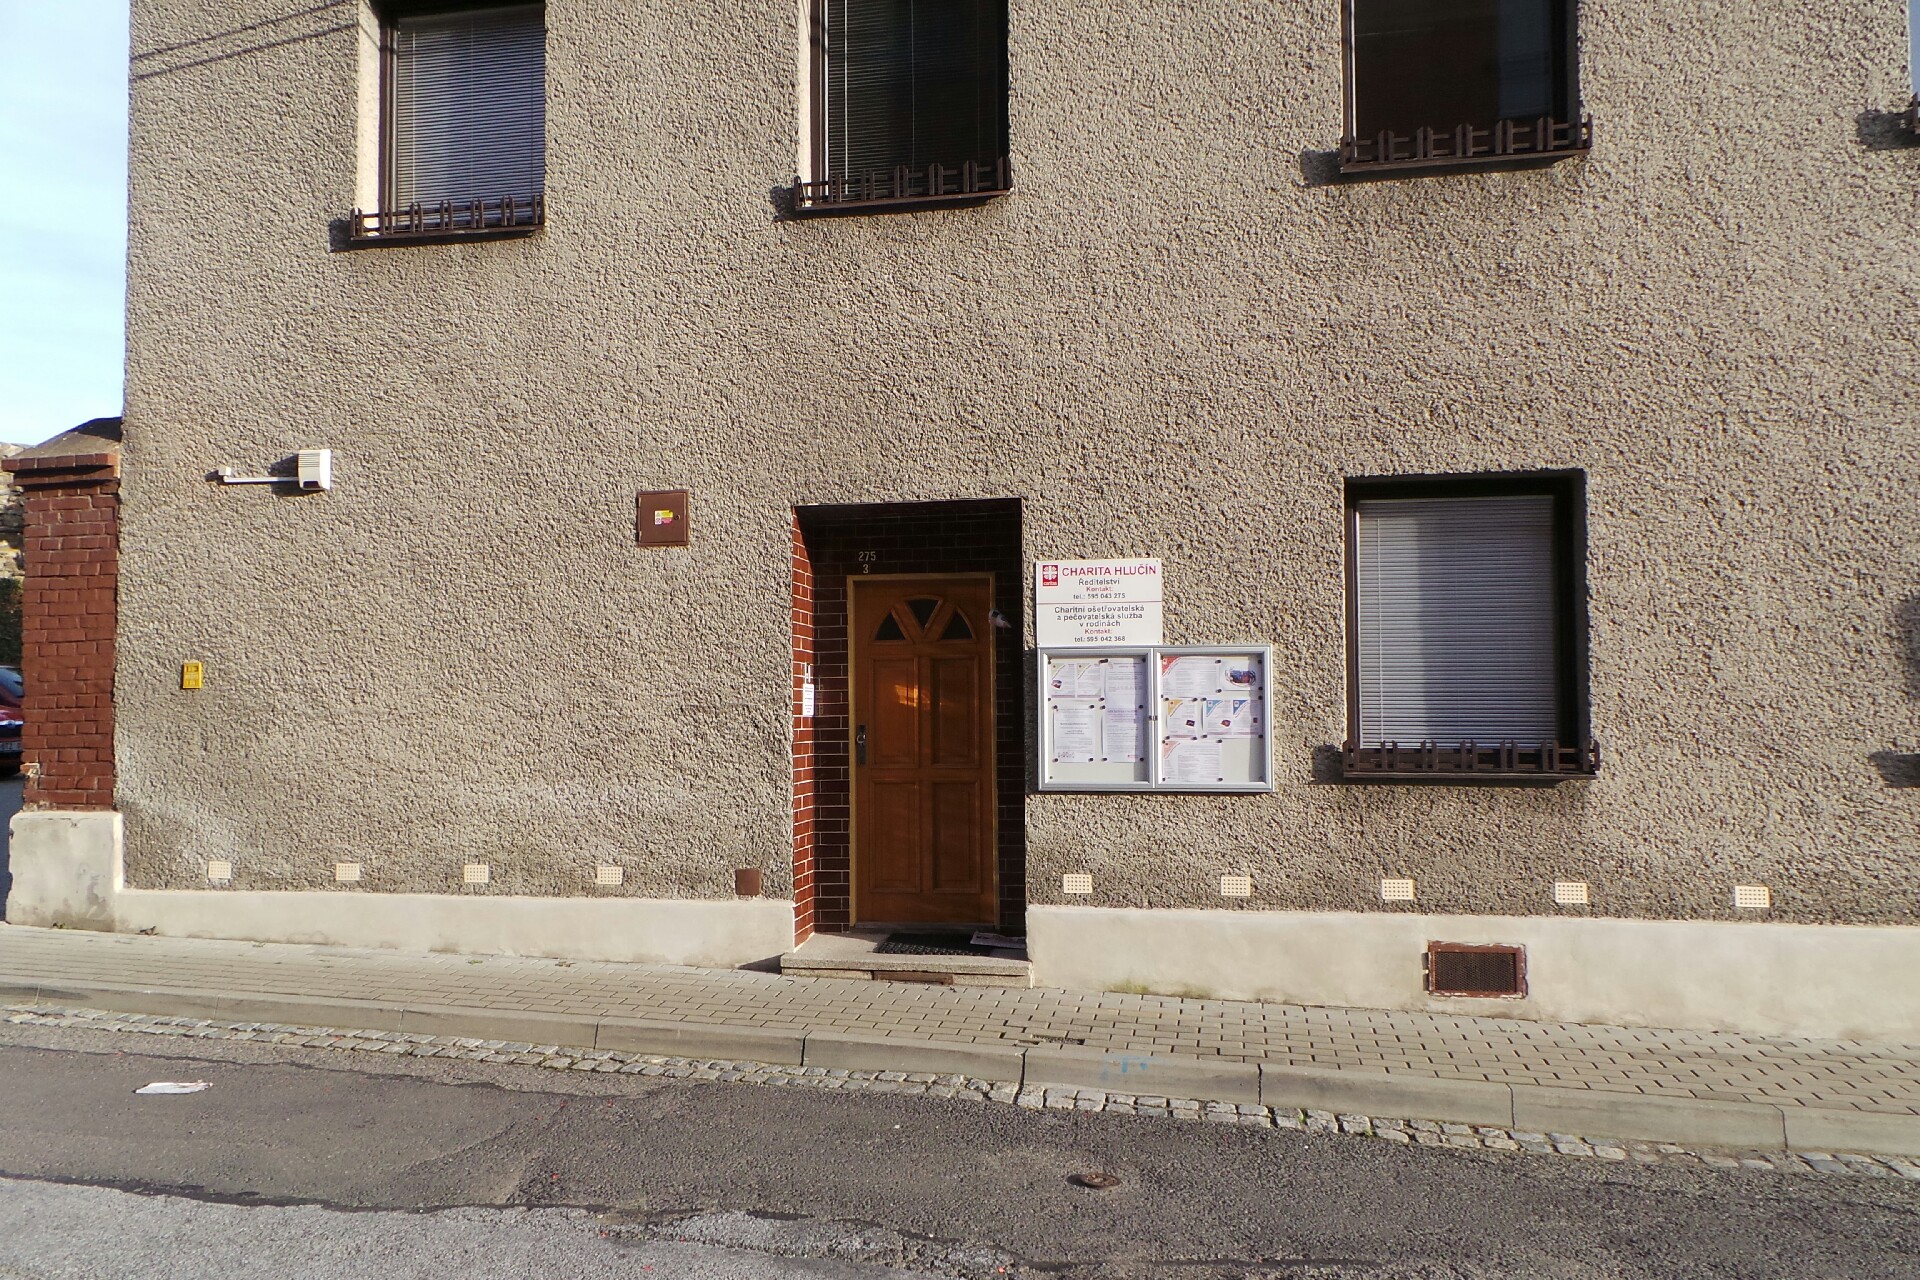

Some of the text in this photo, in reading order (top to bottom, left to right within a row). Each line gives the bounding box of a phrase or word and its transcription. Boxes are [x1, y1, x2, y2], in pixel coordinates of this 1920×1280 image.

[858, 551, 876, 561] 275
[862, 563, 869, 574] 3
[1062, 564, 1156, 576] CHARITA HLUČÍN
[1078, 578, 1120, 586] Ředitelství
[1064, 613, 1114, 622] pečovatelská
